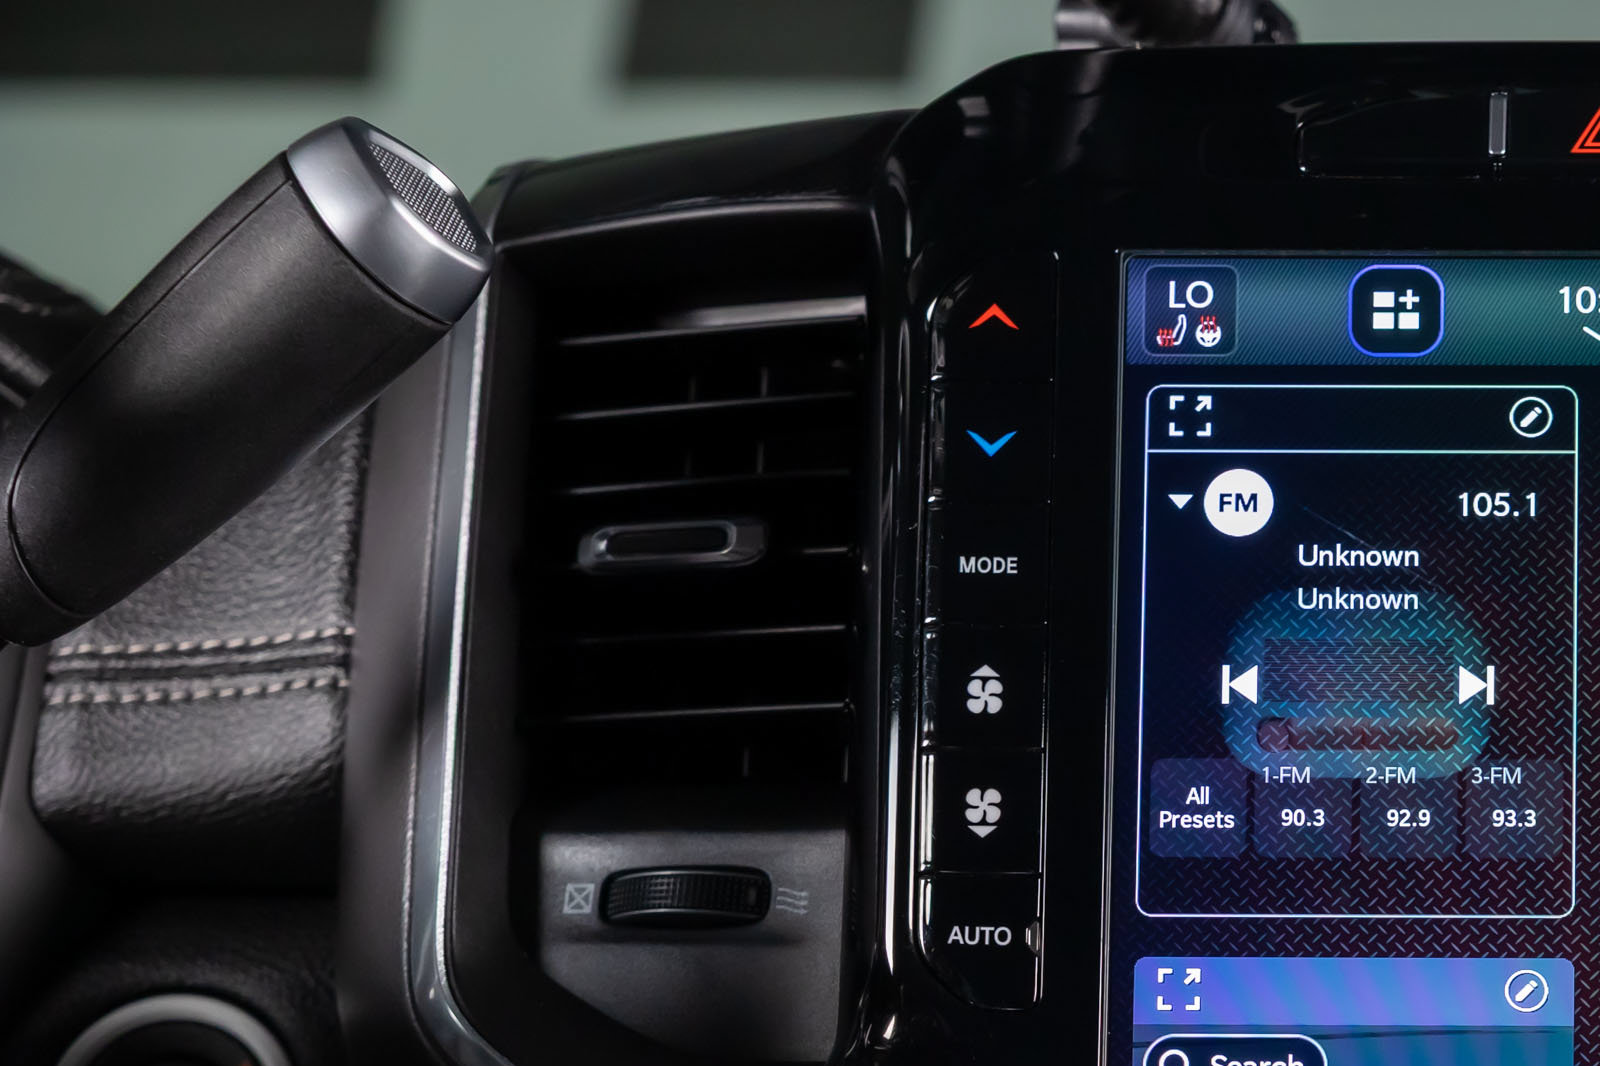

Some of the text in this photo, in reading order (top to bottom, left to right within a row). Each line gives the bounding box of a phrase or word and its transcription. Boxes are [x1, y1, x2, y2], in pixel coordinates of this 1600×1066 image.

[1168, 280, 1214, 309] LO
[1217, 492, 1259, 513] FM
[1458, 492, 1536, 517] 105.1
[959, 555, 1018, 574] MODE
[1298, 543, 1419, 567] Unknown
[1297, 586, 1419, 610] Unknown
[1262, 766, 1311, 784] 1-FM
[1365, 766, 1416, 784] 2-FM
[1471, 766, 1522, 785] 3-FM
[1185, 785, 1210, 805] All
[1159, 810, 1235, 829] Presets
[1281, 808, 1325, 827] 90.3
[1386, 808, 1431, 828] 92.9
[1492, 809, 1537, 828] 93.3
[947, 925, 1012, 946] AUTO
